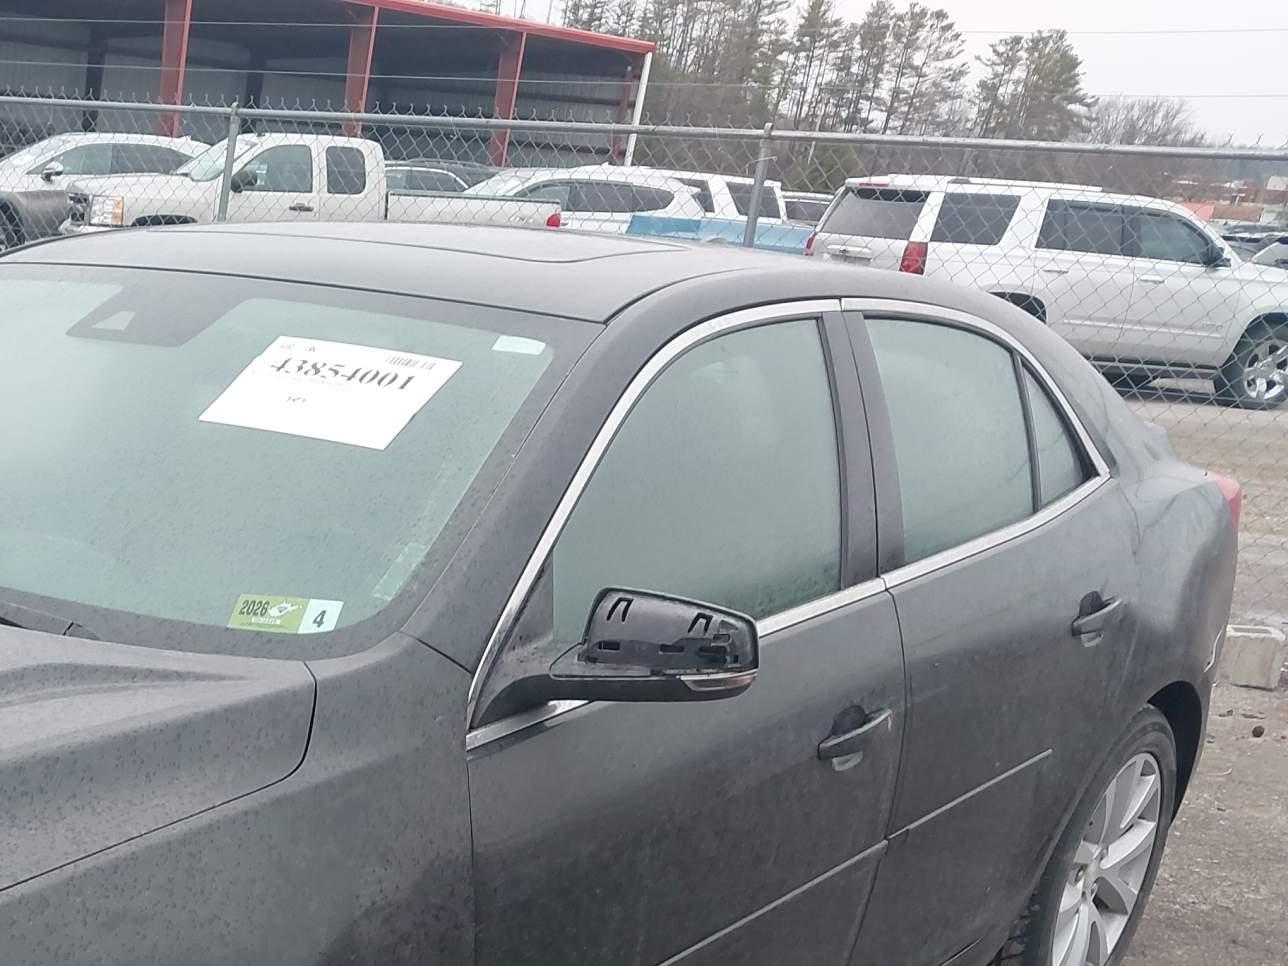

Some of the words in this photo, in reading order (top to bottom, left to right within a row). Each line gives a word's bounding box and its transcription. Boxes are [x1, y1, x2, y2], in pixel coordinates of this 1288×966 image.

[270, 357, 416, 390] 43854001
[238, 600, 270, 617] 2026
[312, 610, 328, 628] 4
